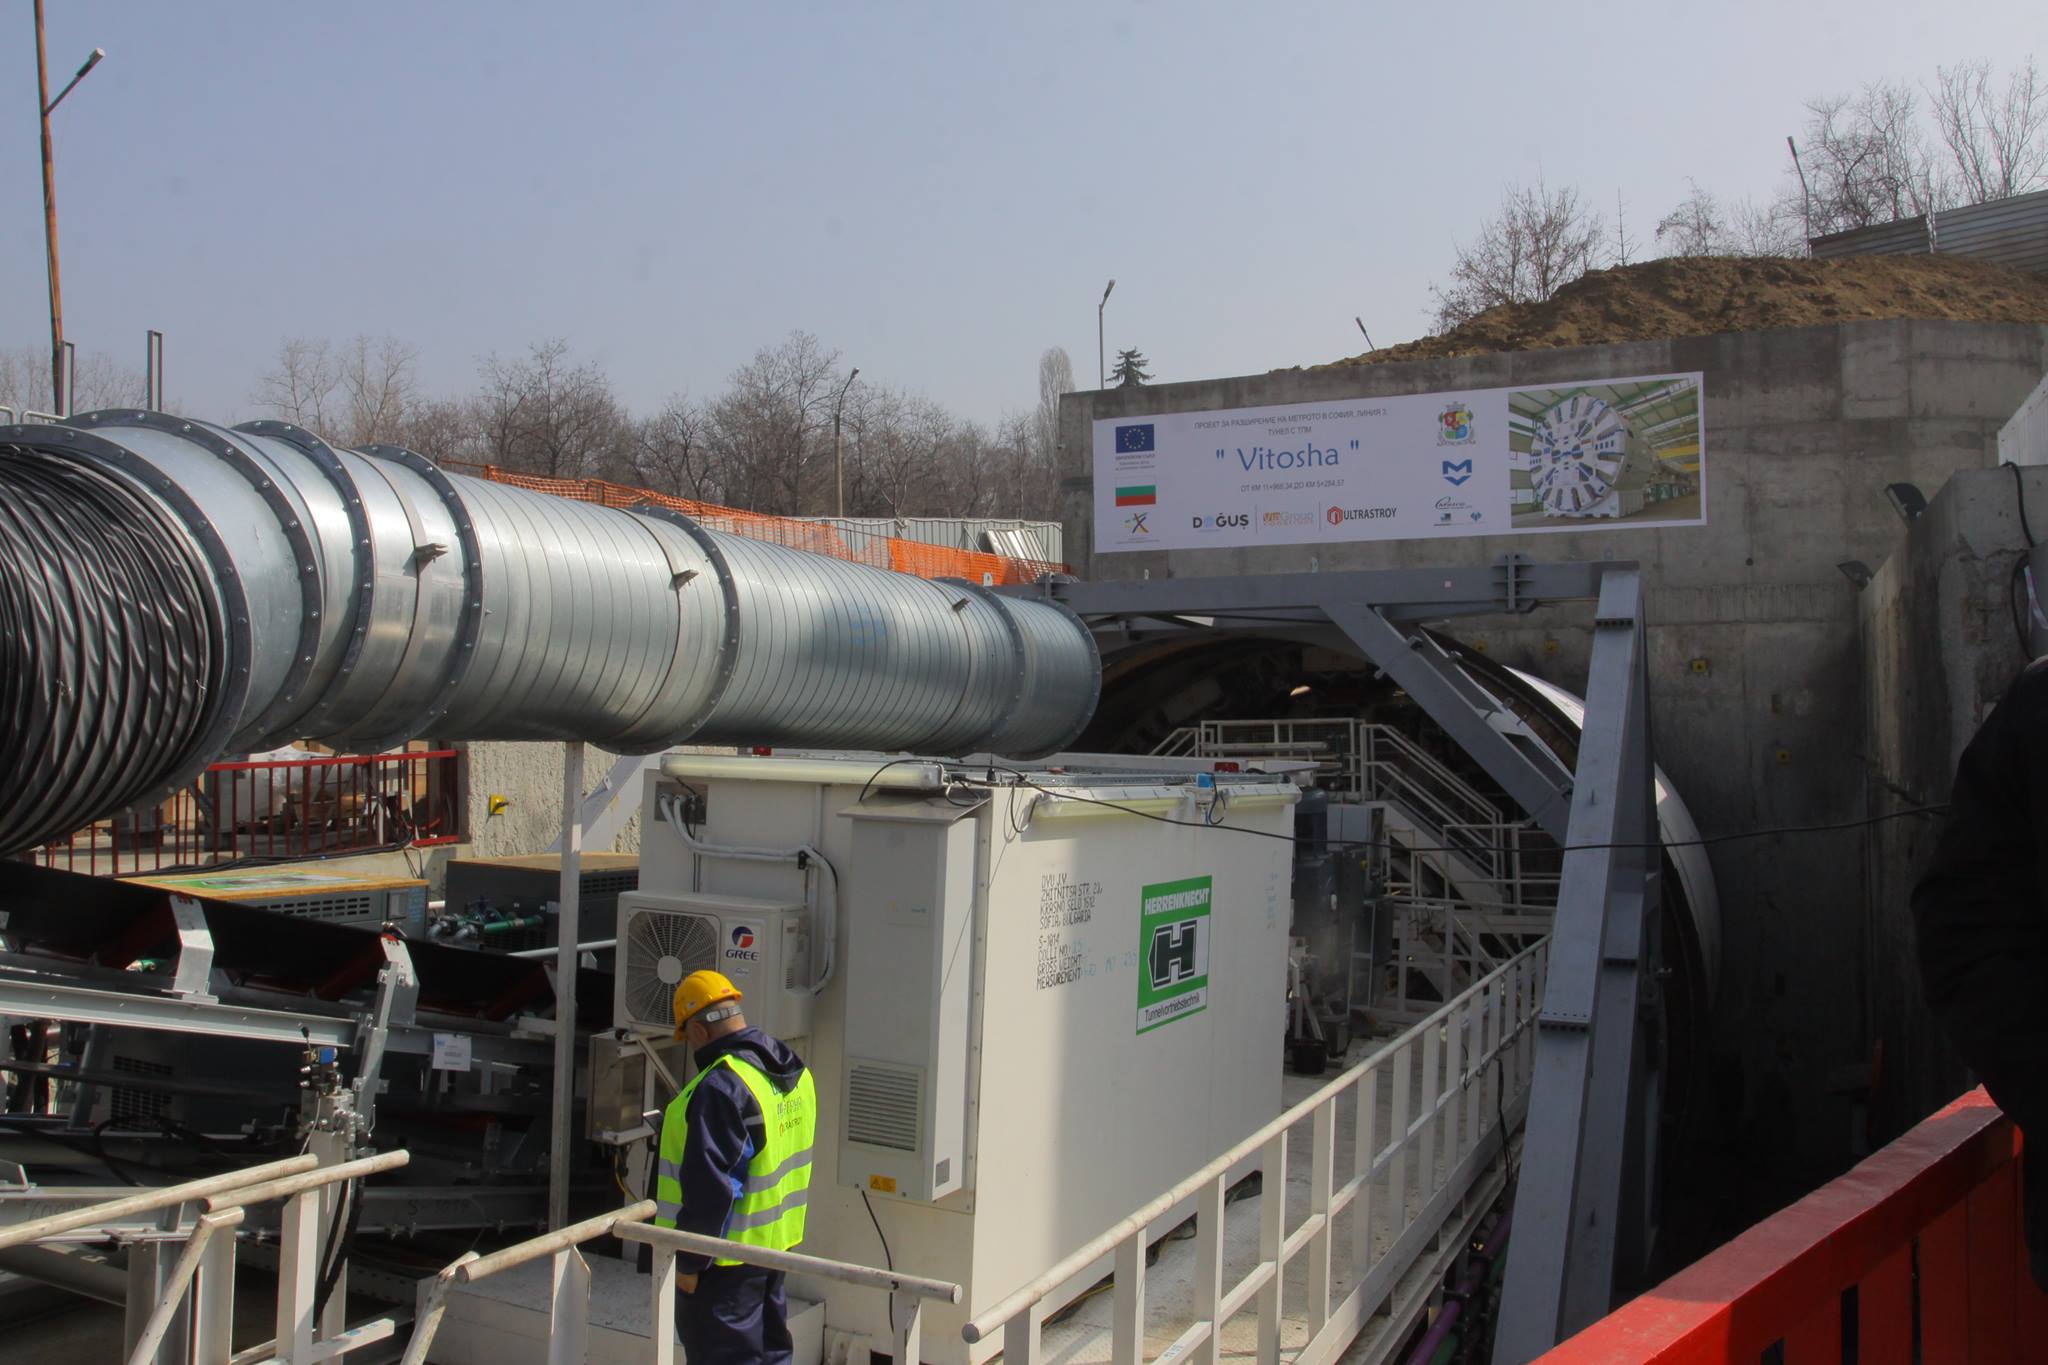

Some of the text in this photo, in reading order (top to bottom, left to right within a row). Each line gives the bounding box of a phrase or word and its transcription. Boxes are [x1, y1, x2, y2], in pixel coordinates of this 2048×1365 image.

[1194, 420, 1220, 429] ПРОЕКТ
[1231, 416, 1276, 427] РАЗШИРЕНИЕ
[1289, 412, 1321, 422] МЕТРОТО
[1237, 443, 1340, 471] Vitosha
[1344, 507, 1397, 520] ULTRASTROY
[1144, 888, 1210, 915] HERRENKNECHT
[1063, 909, 1092, 926] BULGARIA
[725, 949, 760, 961] GREE
[1036, 967, 1081, 992] MEASUREMENT
